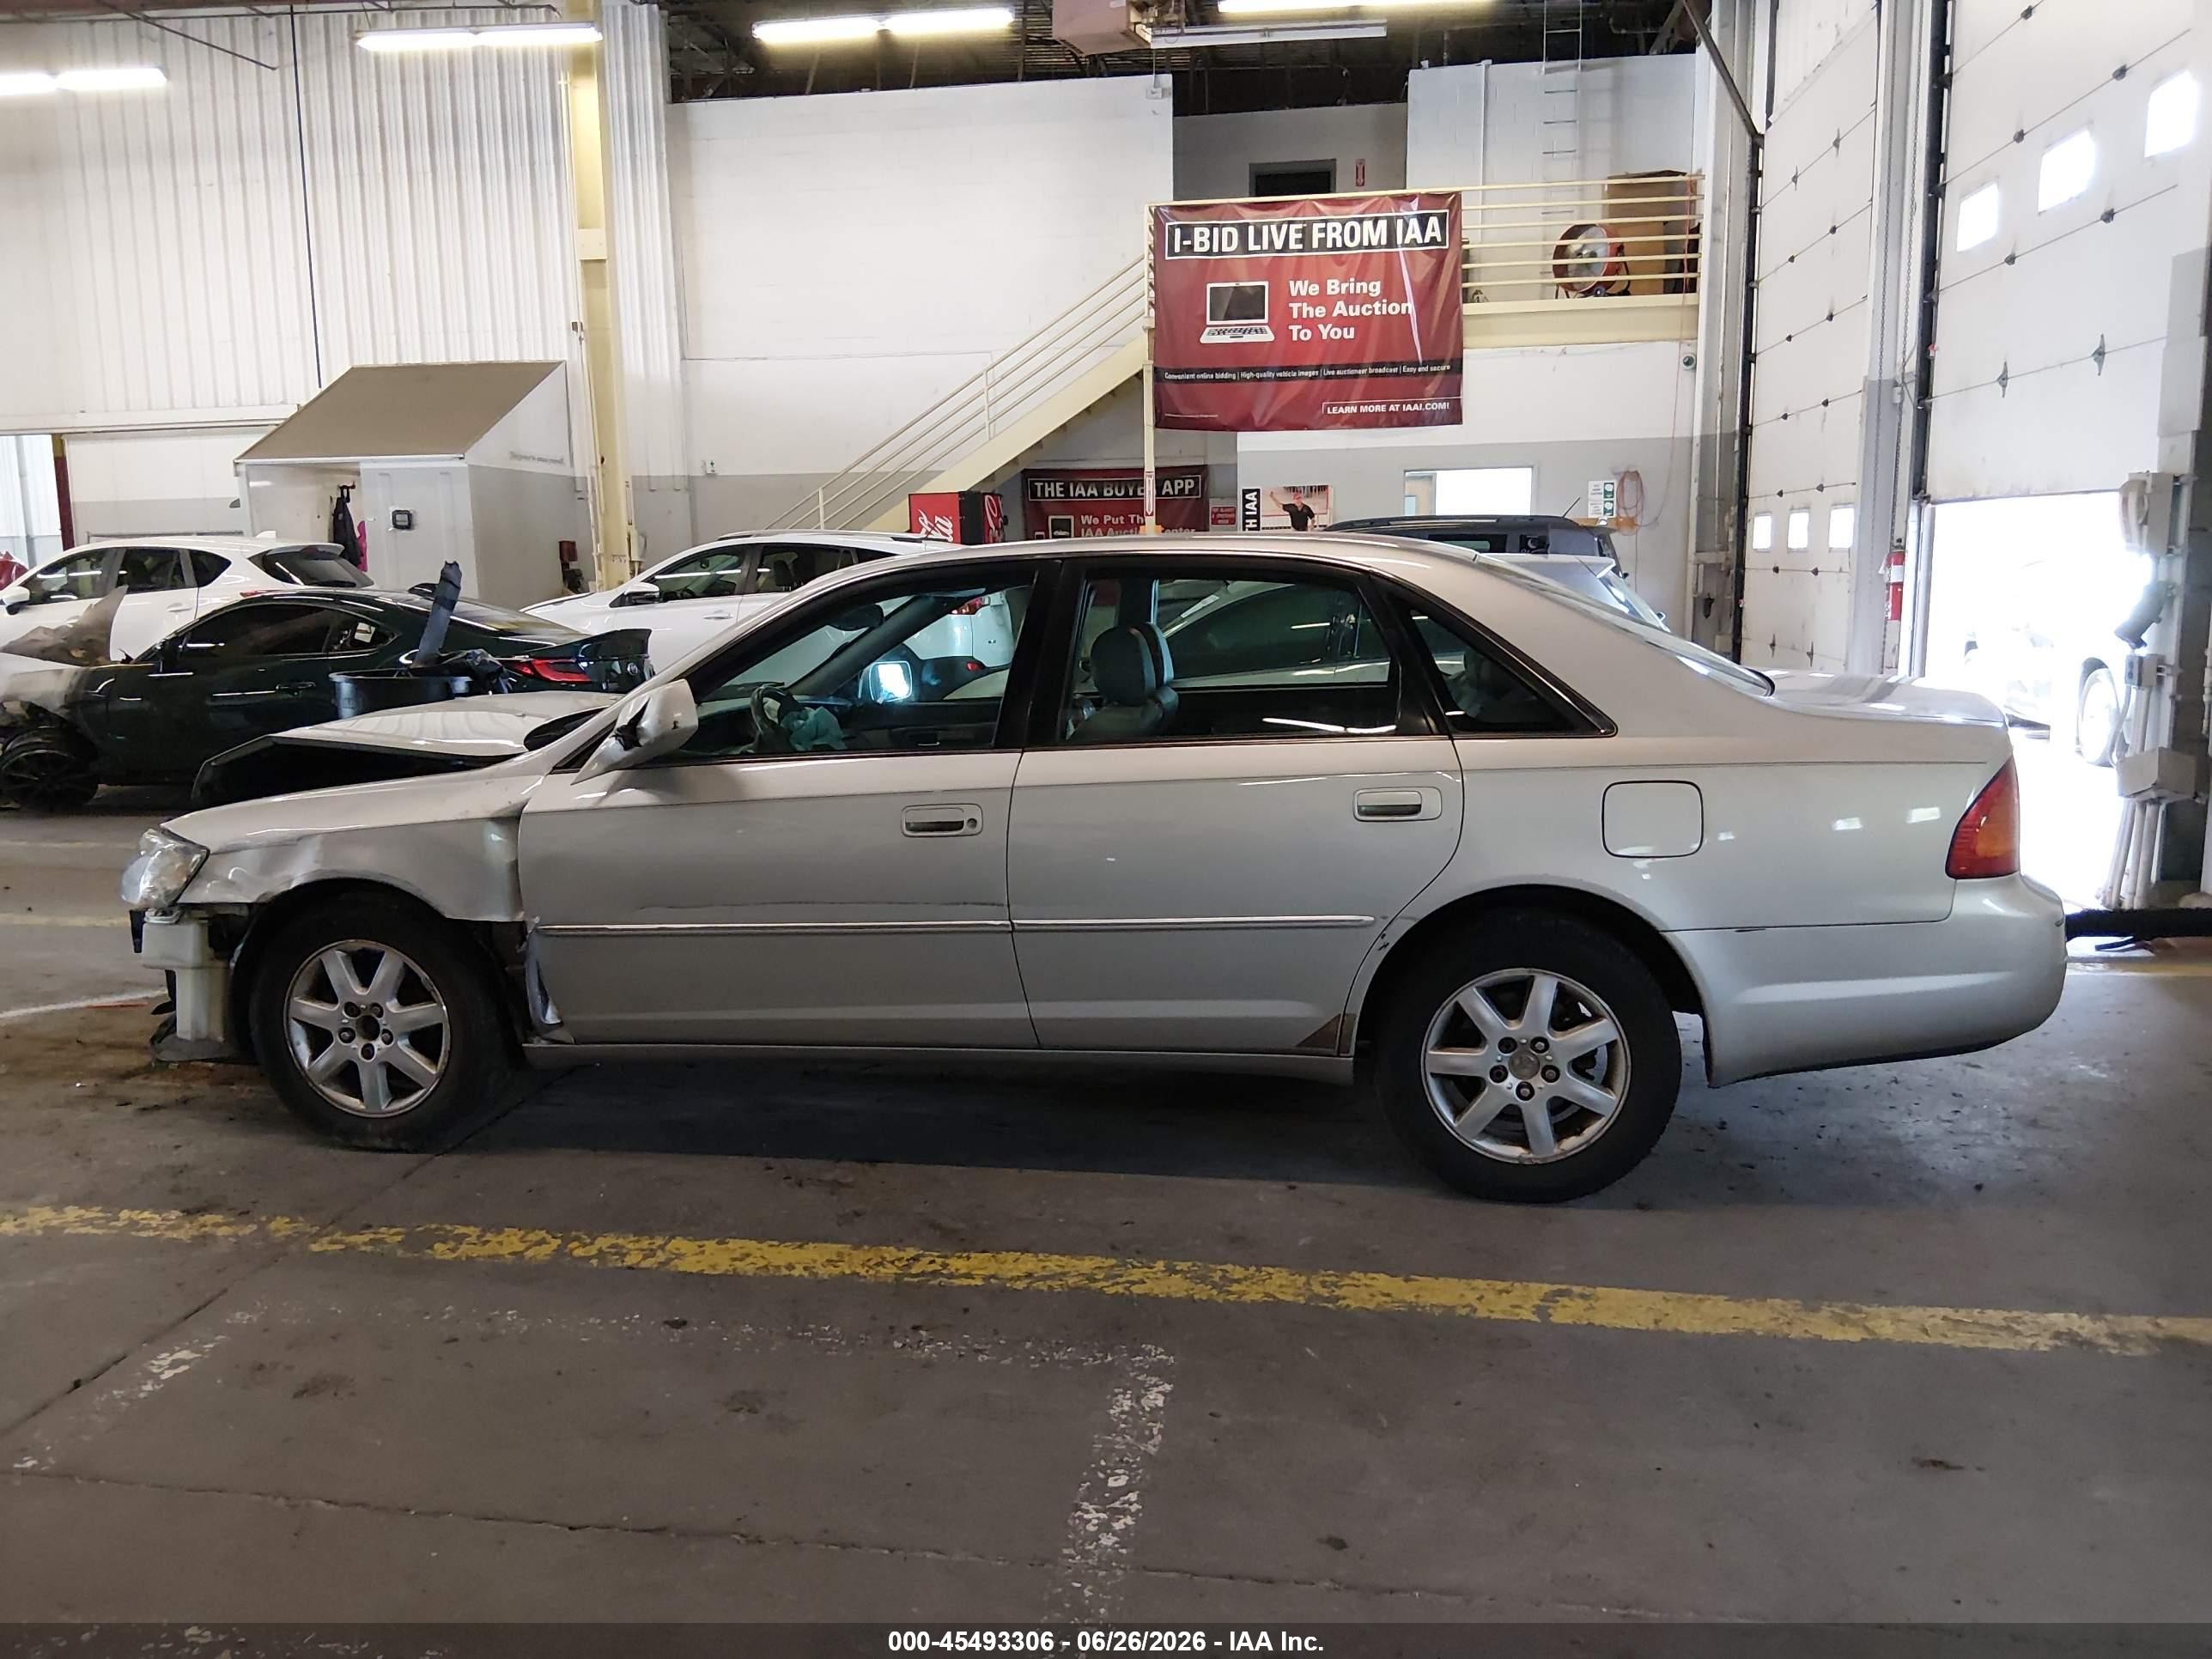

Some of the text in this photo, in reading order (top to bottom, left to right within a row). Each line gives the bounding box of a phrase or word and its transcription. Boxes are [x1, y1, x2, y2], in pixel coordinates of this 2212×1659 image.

[1174, 216, 1443, 253] I-BID LIVE FROM IAA
[1289, 277, 1381, 297] We Bring
[1289, 299, 1413, 319] The Auction
[1289, 324, 1355, 341] To You
[1215, 372, 1237, 380] bidding
[1241, 370, 1275, 380] High-quality
[1297, 369, 1319, 378] images
[1336, 368, 1367, 376] auctioneer
[1402, 365, 1417, 374] Easy
[1327, 402, 1450, 415] LEARN MORE AT IAAI.COM!
[1034, 482, 1065, 498] THE
[1069, 482, 1098, 497] IAA
[1103, 481, 1156, 496] BUYE
[1162, 478, 1194, 495] APP
[1245, 491, 1258, 515] IAA
[1080, 514, 1146, 525] We Put Th
